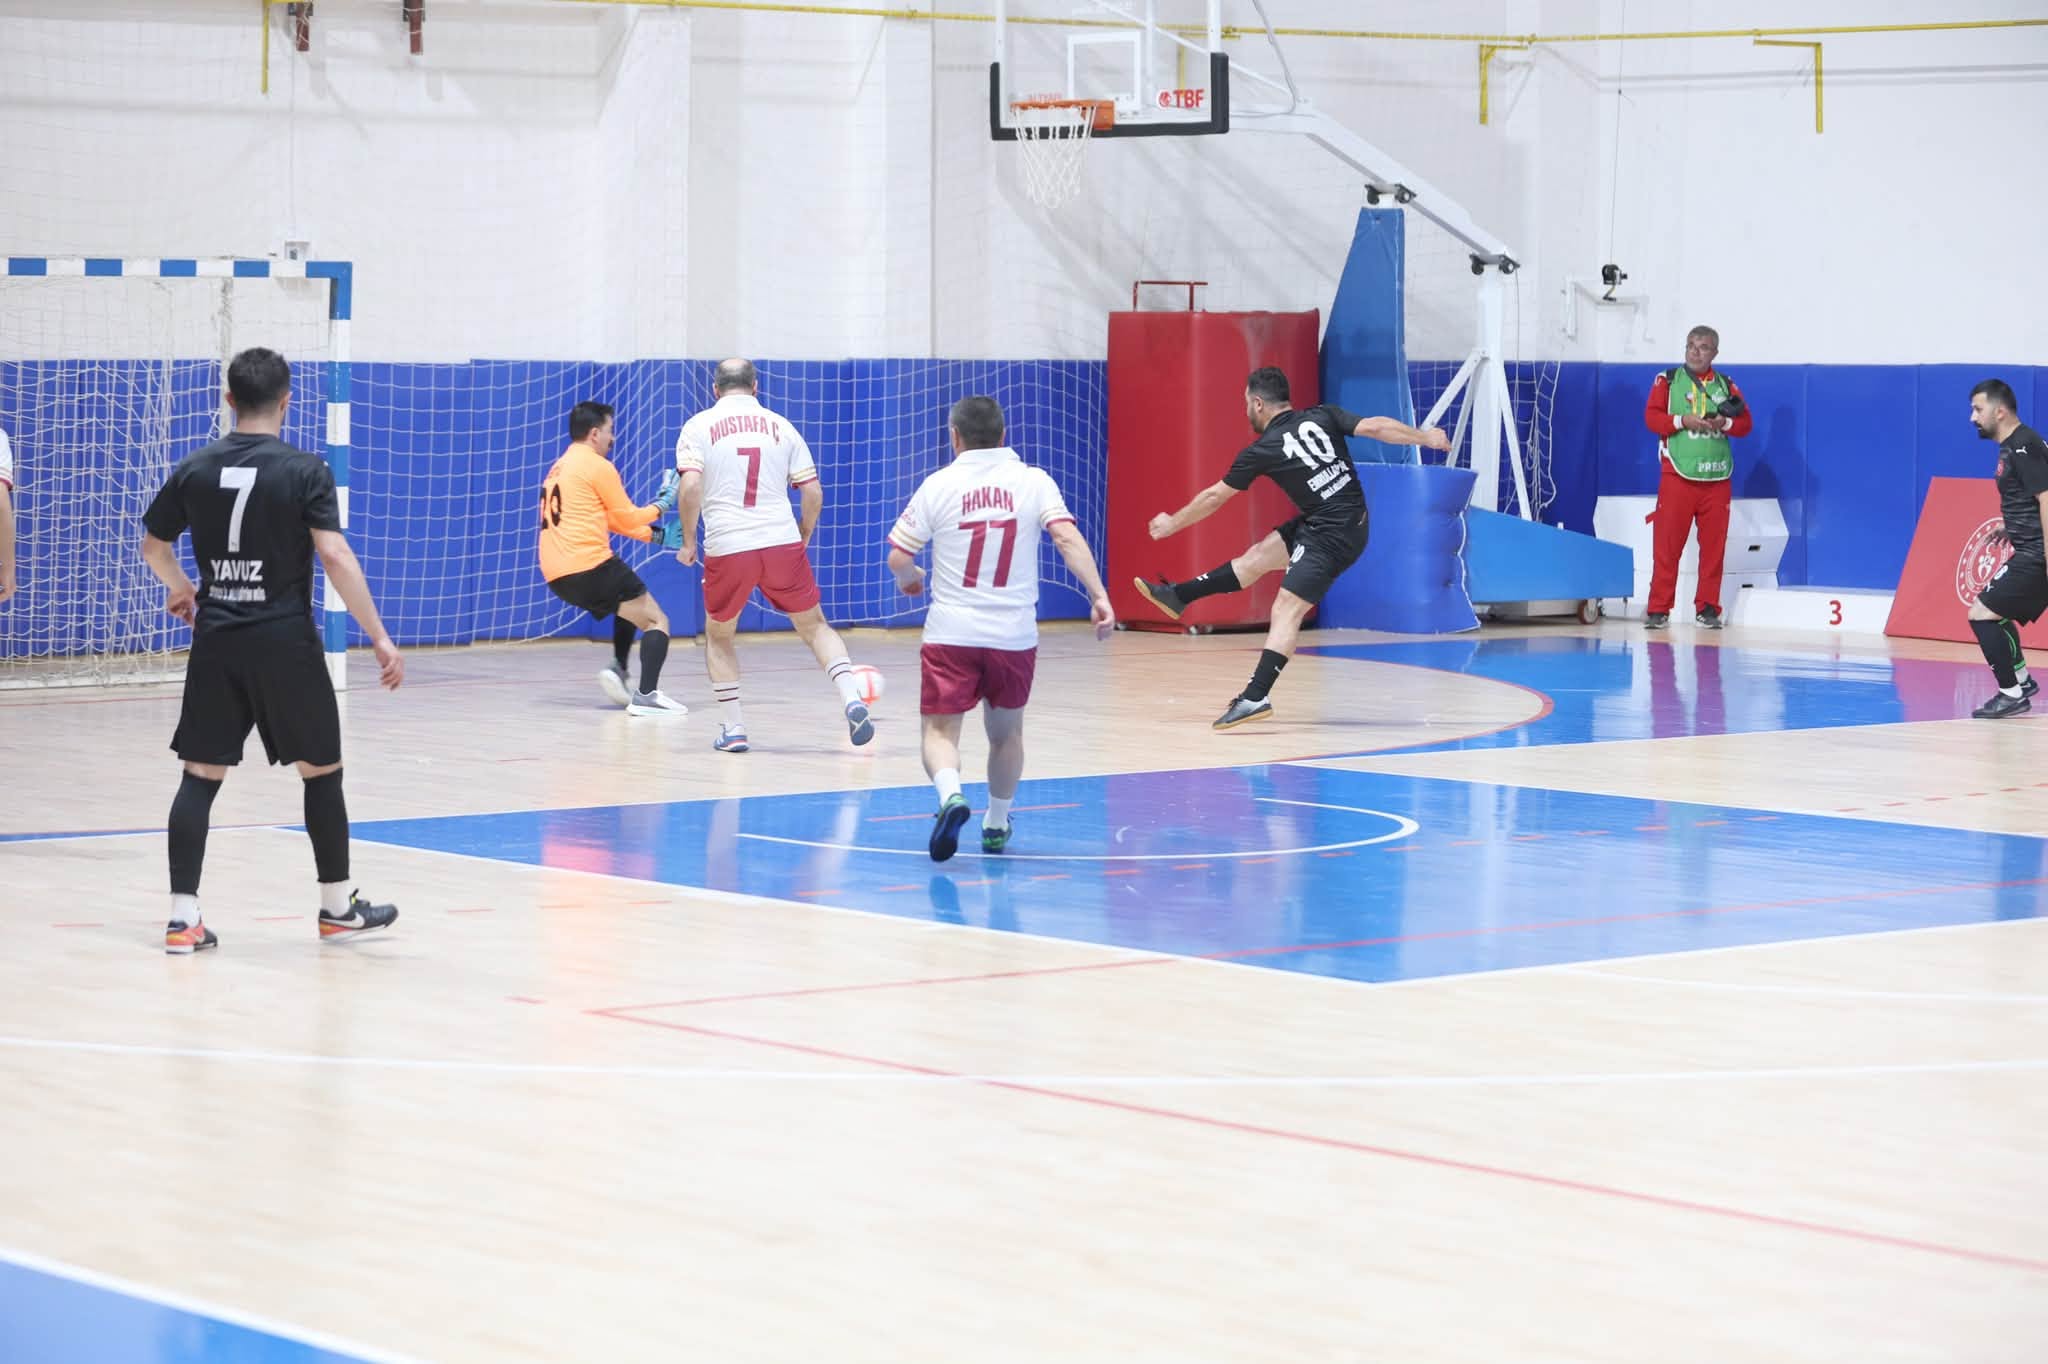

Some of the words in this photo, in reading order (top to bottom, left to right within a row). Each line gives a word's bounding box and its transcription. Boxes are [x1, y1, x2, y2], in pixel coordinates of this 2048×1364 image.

[1173, 89, 1205, 108] TBF
[710, 415, 769, 446] MUSTAFA
[1282, 421, 1337, 470] 10
[736, 447, 761, 508] 7
[219, 467, 258, 553] 7
[962, 486, 1014, 516] HAKAN
[958, 518, 1017, 588] 77
[210, 560, 263, 582] YAVUZ
[1829, 600, 1842, 625] 3
